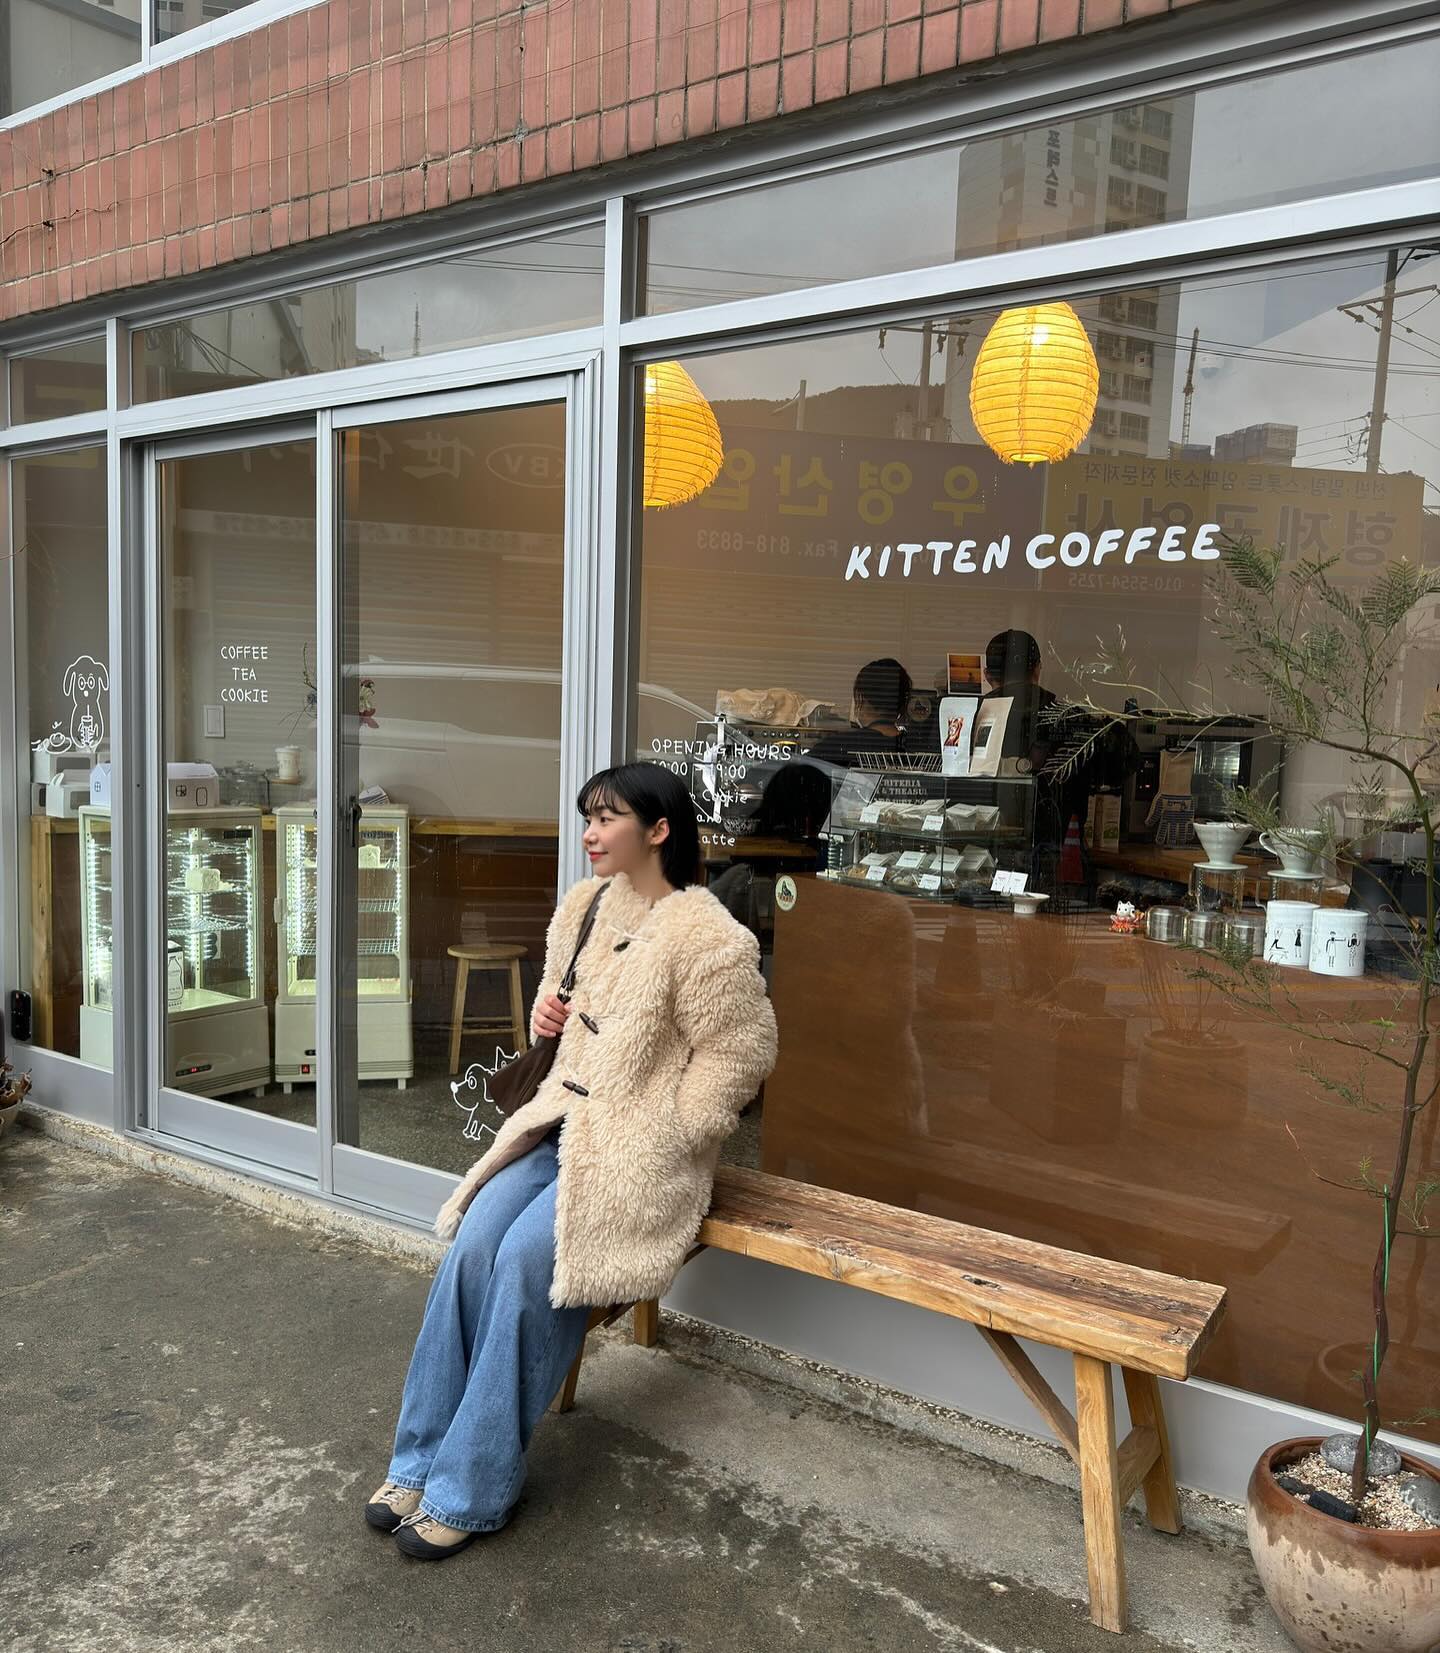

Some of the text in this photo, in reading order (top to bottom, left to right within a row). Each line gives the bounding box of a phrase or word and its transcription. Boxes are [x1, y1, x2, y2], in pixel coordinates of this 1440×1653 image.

[845, 535, 1011, 581] KITTEN
[1025, 523, 1221, 569] COFFEE
[220, 645, 268, 660] COFFEE
[231, 667, 257, 681] TEA
[220, 688, 268, 703] COOKIE
[651, 738, 792, 761] OPENING HOURS
[701, 833, 736, 847] atte
